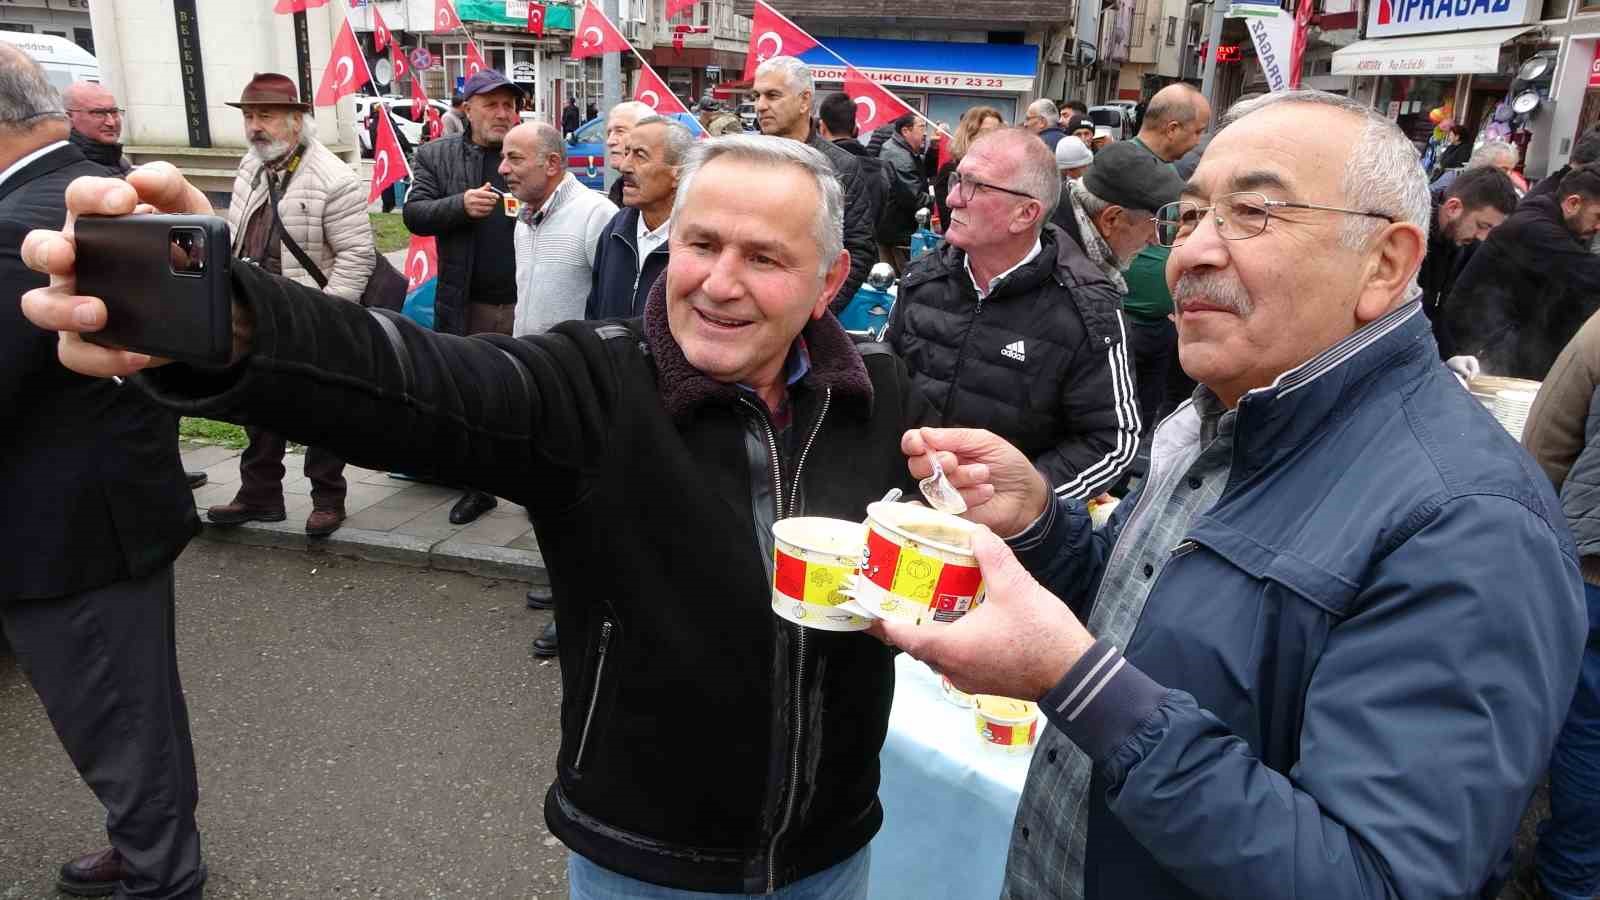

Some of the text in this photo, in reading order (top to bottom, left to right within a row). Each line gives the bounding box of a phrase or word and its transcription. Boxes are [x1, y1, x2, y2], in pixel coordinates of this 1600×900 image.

[15, 40, 54, 54] edding
[809, 69, 847, 80] RDON
[934, 76, 959, 86] 517
[965, 78, 981, 87] 23
[986, 79, 1003, 88] 23
[1000, 348, 1025, 362] adidas
